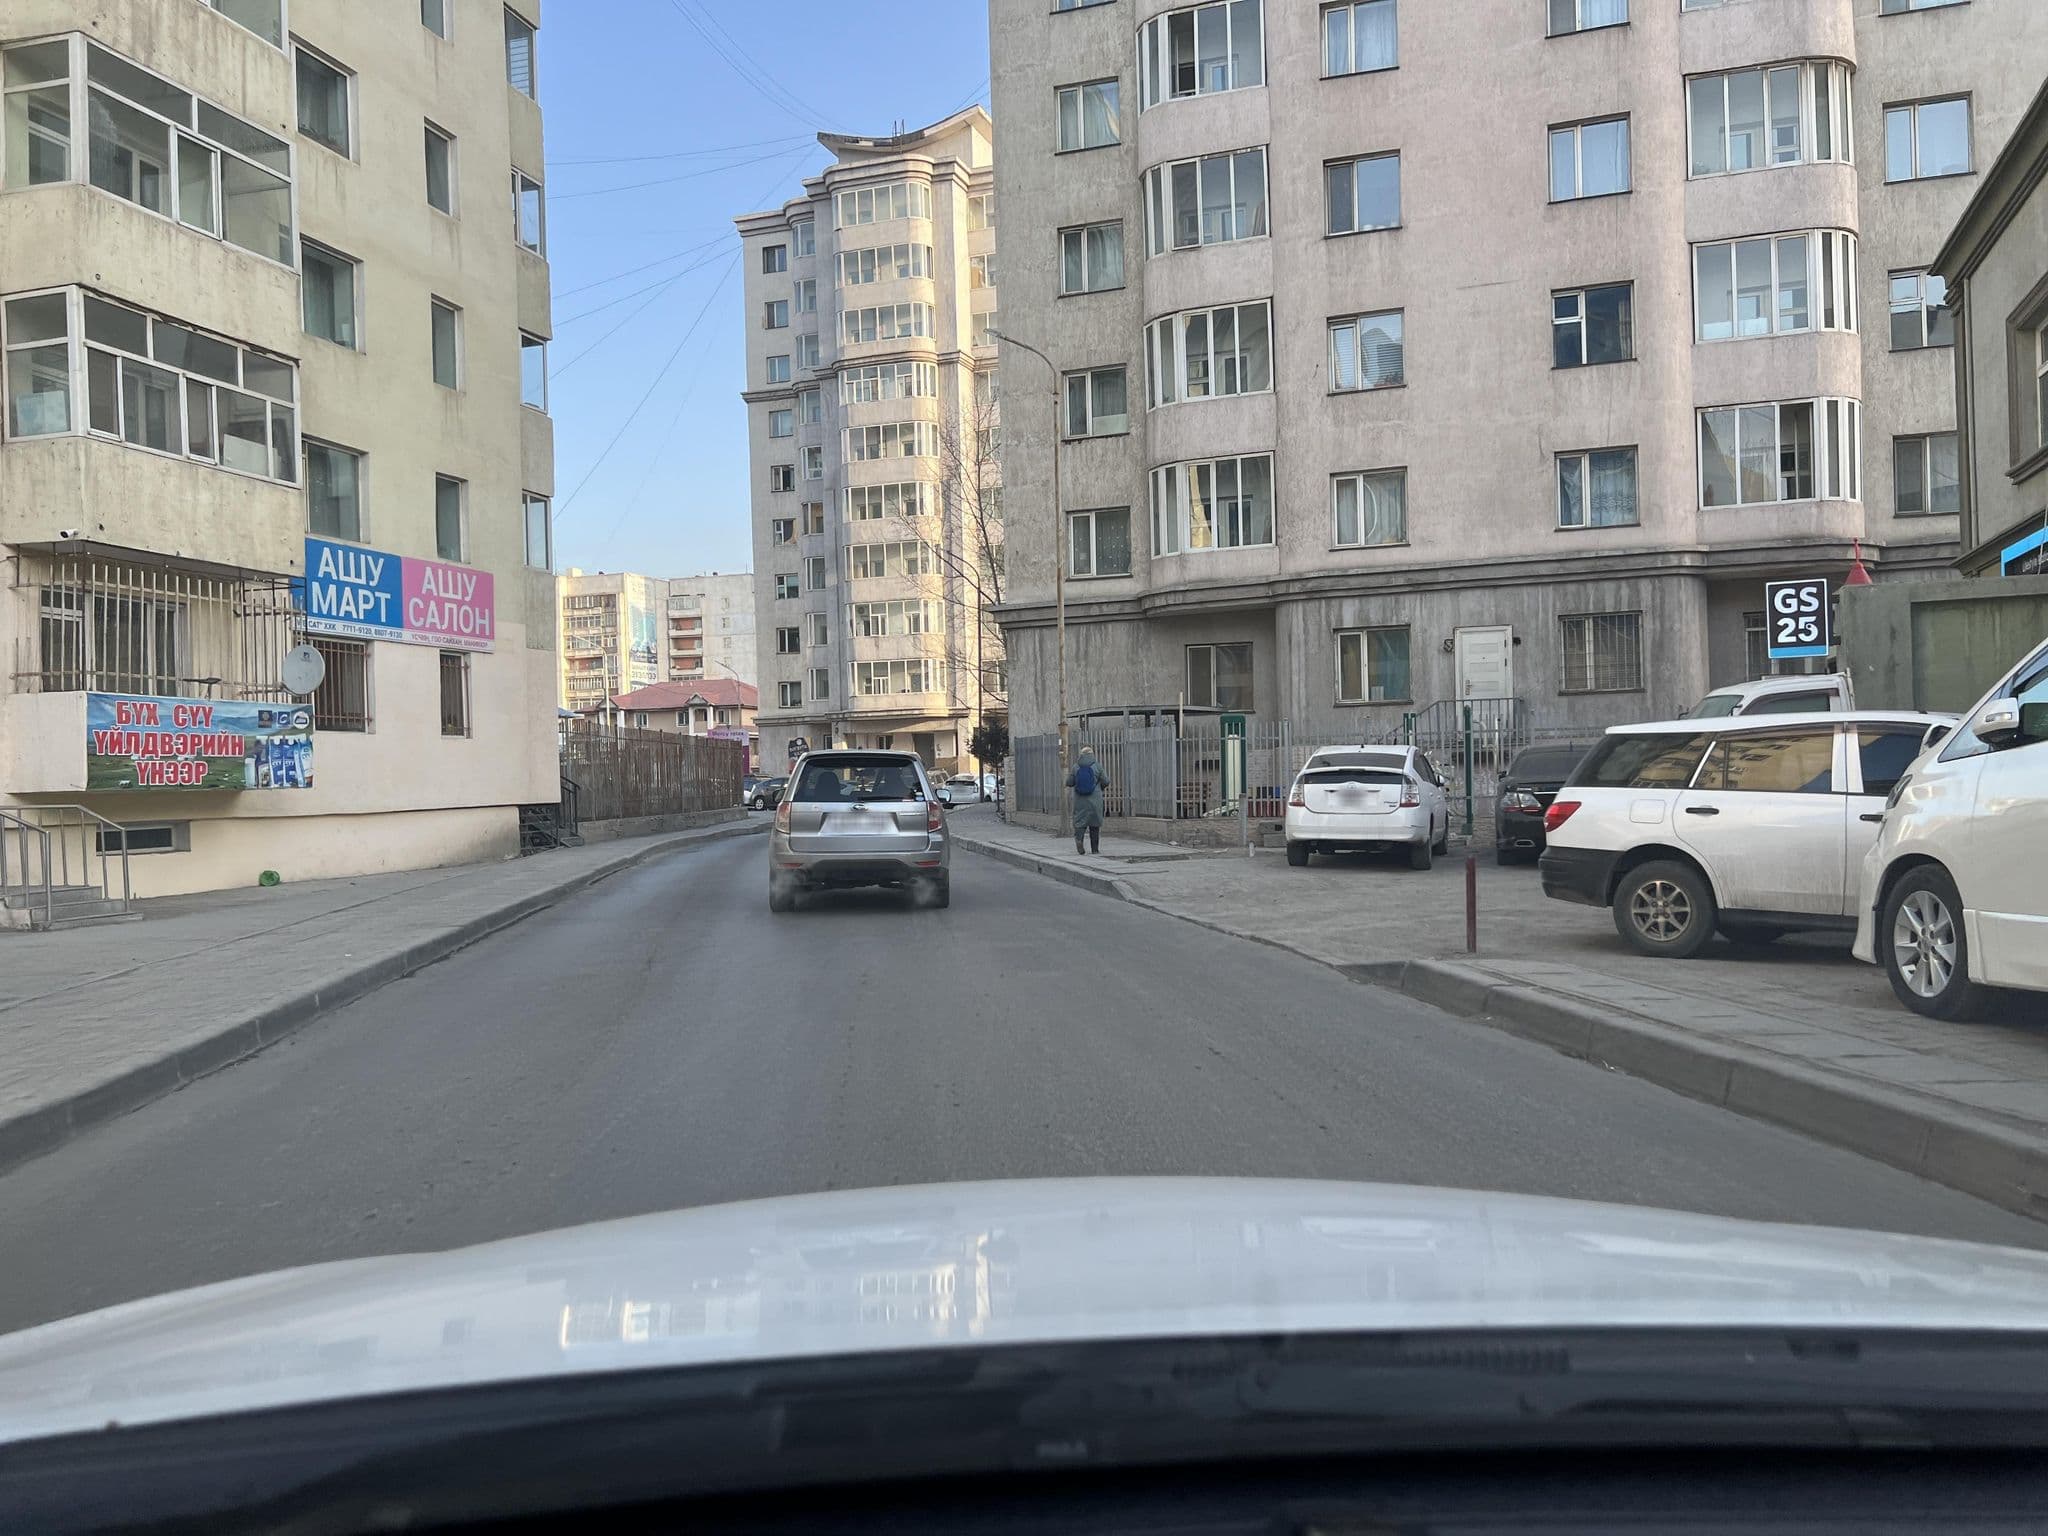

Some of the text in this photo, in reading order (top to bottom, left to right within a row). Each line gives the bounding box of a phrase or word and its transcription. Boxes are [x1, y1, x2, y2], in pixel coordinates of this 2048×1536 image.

[317, 546, 385, 587] АШУ
[421, 566, 477, 602] АШУ
[1774, 586, 1819, 614] GS
[311, 581, 391, 623] МАРТ
[408, 597, 490, 636] САЛОН
[1776, 616, 1819, 643] 25
[115, 701, 214, 729] БҮХ СҮҮ
[93, 725, 246, 758] ҮЙЛДВЭРИЙН
[135, 761, 209, 786] ҮНЭЭР
